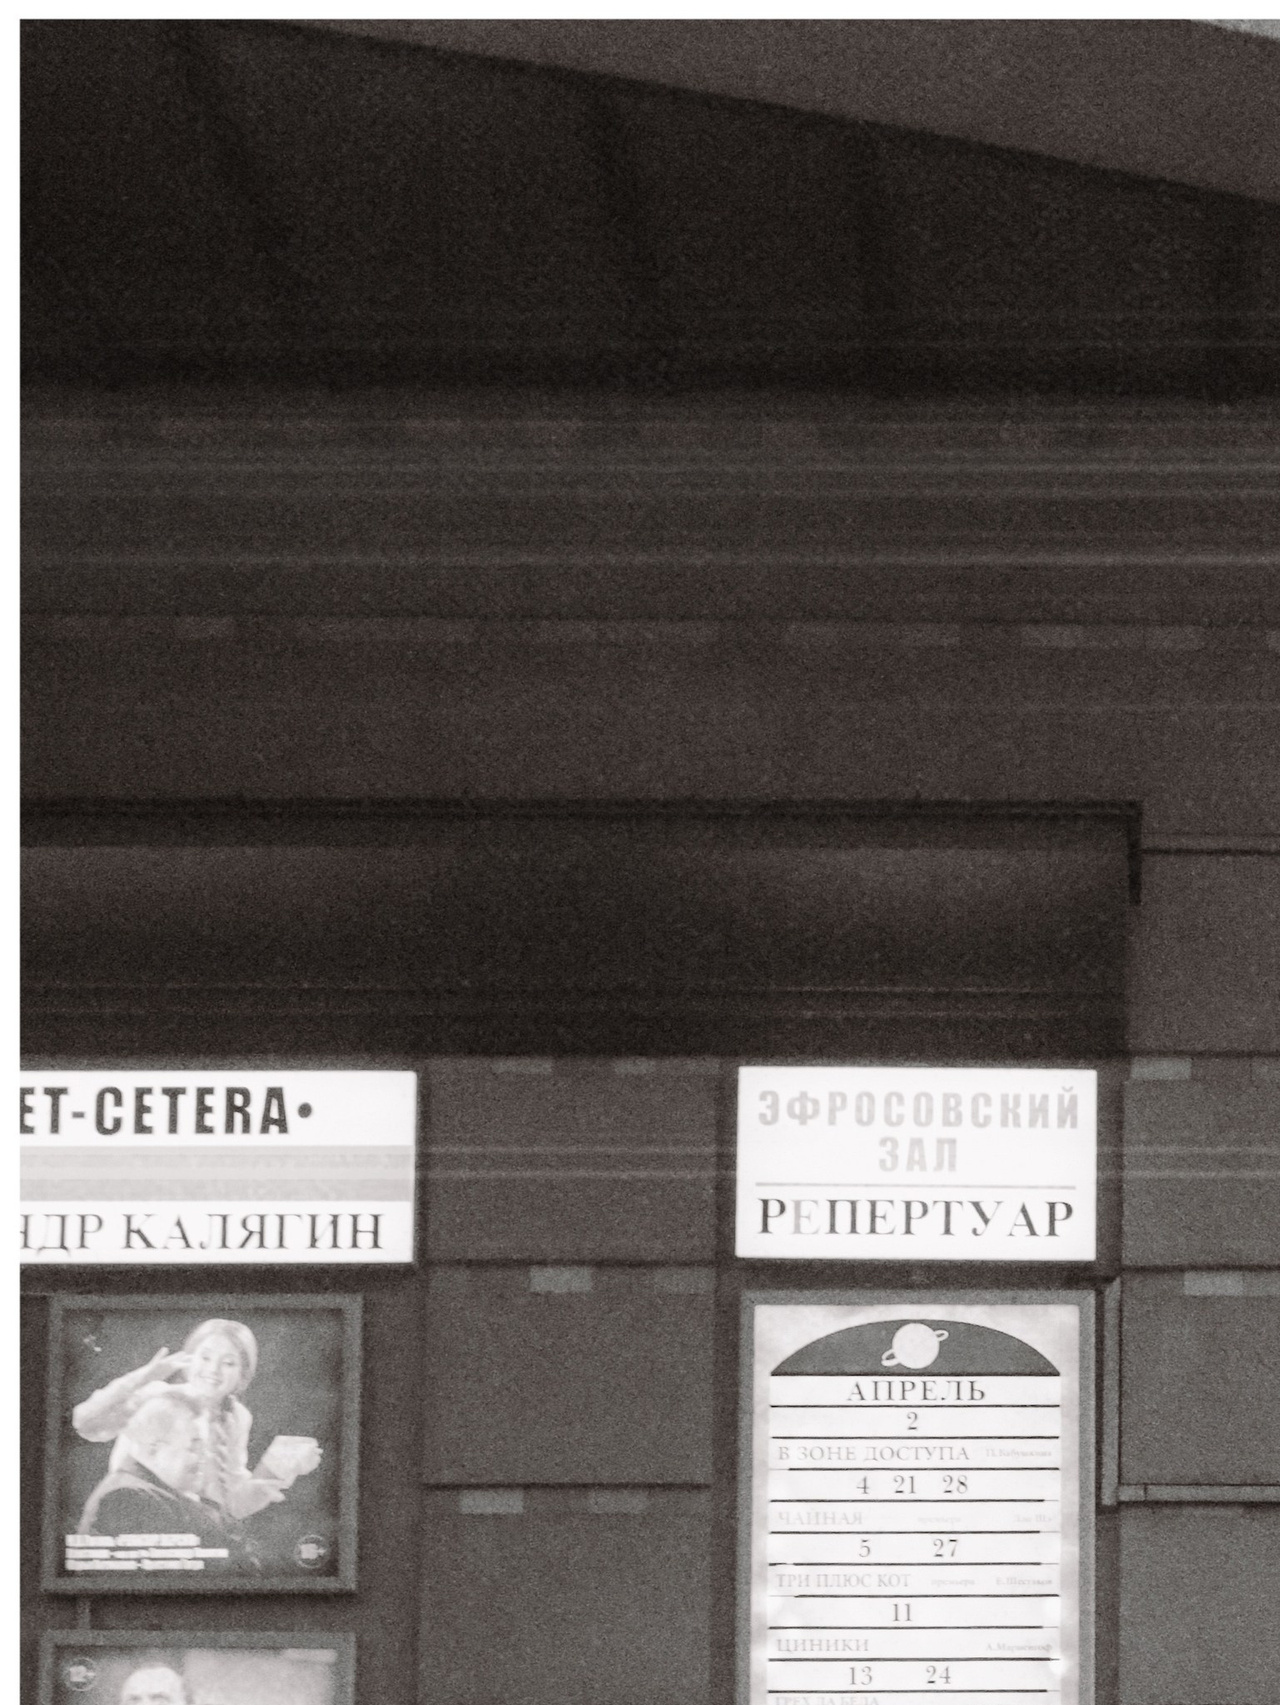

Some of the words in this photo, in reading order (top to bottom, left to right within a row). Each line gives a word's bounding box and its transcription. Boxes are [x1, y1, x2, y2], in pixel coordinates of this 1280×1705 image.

[758, 1086, 1078, 1129] ЭФРОСОВСКИЙ
[879, 1136, 957, 1172] ЗАЛ
[757, 1198, 1074, 1237] РЕПЕРТУАР
[122, 1213, 384, 1250] КАЛЯГИН
[848, 1381, 986, 1401] АПРЕЛЬ
[907, 1412, 918, 1430] 2
[777, 1446, 790, 1461] В
[799, 1446, 856, 1461] ЗОНЕ
[864, 1446, 970, 1461] ДОСТУПА
[856, 1476, 870, 1495] 4
[894, 1475, 915, 1494] 21
[943, 1475, 968, 1494] 28
[859, 1539, 871, 1557] 5
[934, 1539, 958, 1558] 27
[775, 1573, 811, 1588] ТРИ
[816, 1573, 871, 1588] ПЛЮС
[877, 1574, 910, 1587] КОТ
[893, 1603, 911, 1622] 11
[776, 1639, 869, 1654] ЦИНИКИ
[850, 1666, 873, 1685] 13
[926, 1665, 950, 1684] 24
